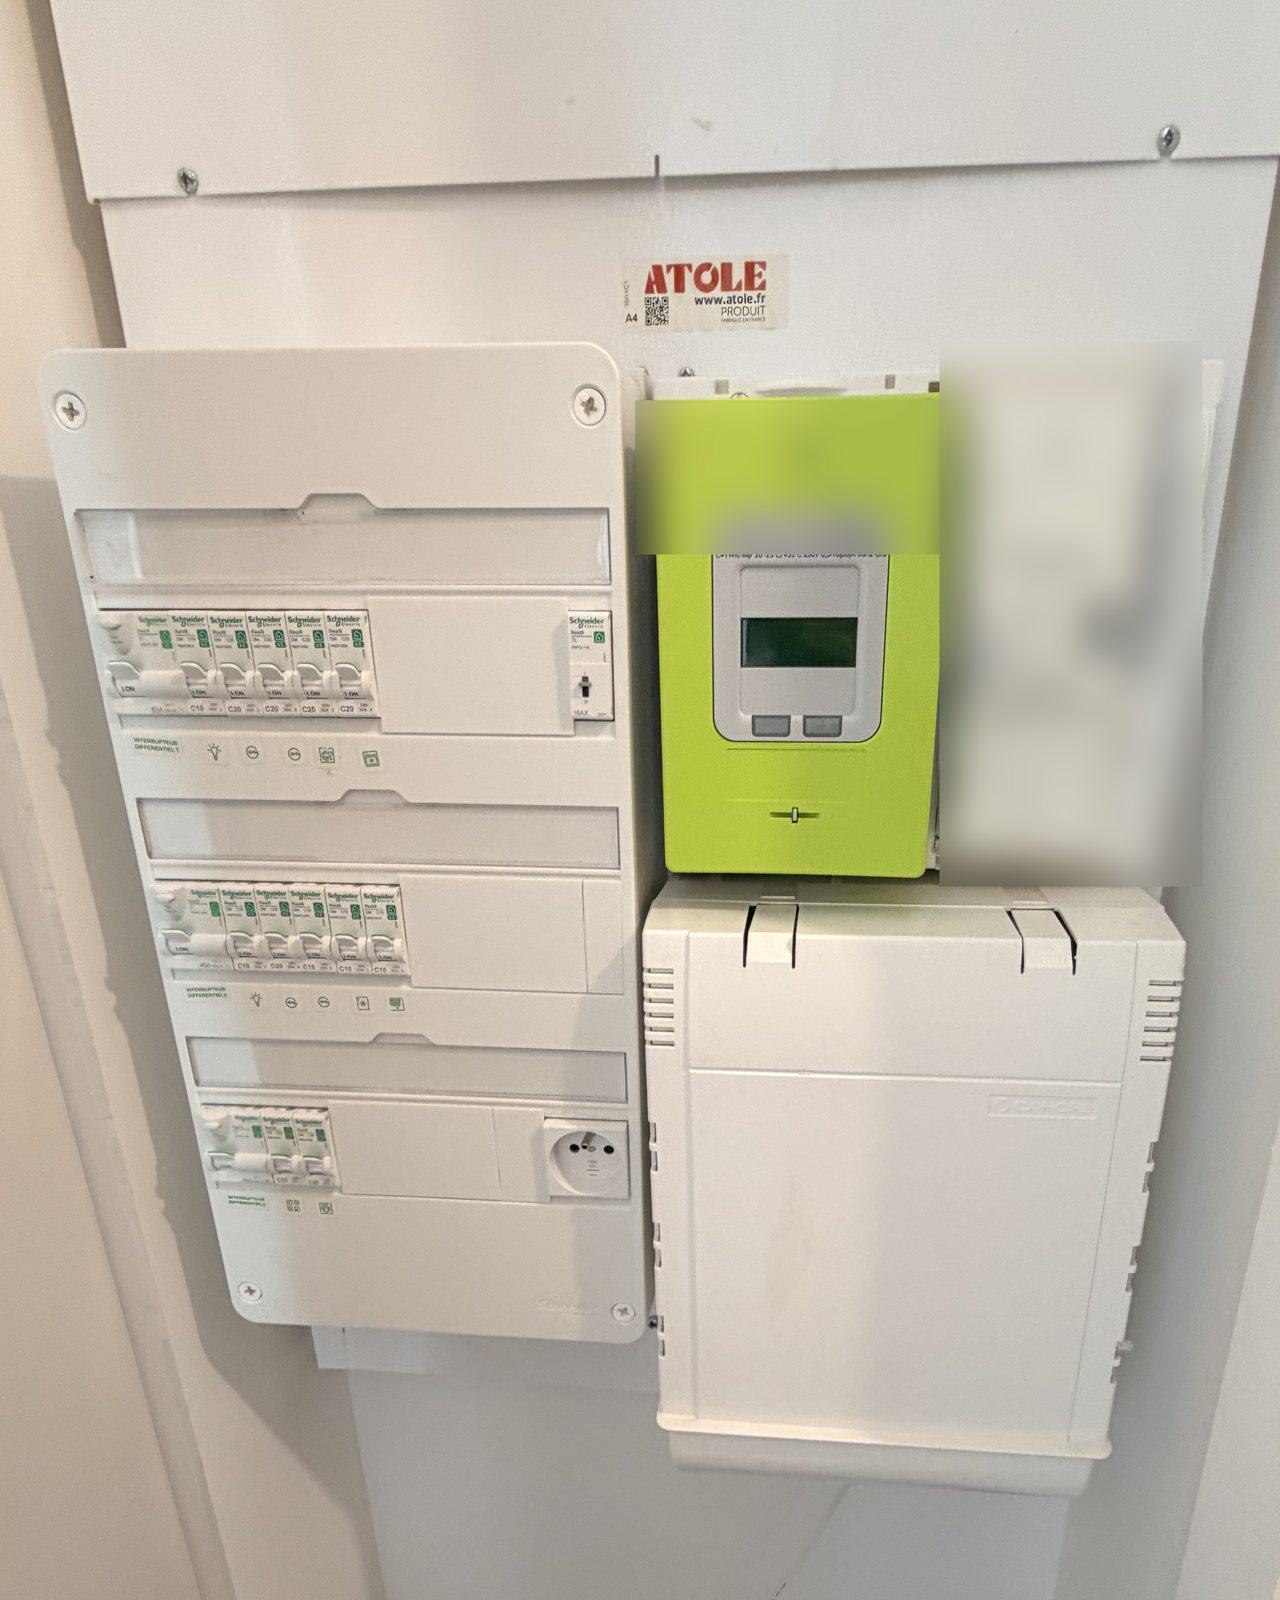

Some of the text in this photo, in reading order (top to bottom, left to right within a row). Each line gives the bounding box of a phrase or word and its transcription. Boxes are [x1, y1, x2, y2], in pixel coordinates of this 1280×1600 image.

[644, 261, 767, 294] ATOLE
[694, 292, 766, 305] www.atole.fr
[721, 305, 766, 317] PRODUIT
[625, 313, 638, 323] A4
[171, 615, 204, 627] Schneider
[210, 616, 243, 628] Schneider
[248, 615, 282, 628] Schneider
[287, 615, 321, 628] Schneider
[326, 615, 360, 627] Schneider
[569, 616, 604, 629] Schneider
[228, 705, 241, 713] C20
[222, 890, 252, 899] Schneider
[256, 889, 287, 900] Schneider
[290, 891, 321, 900] Schneider
[328, 892, 358, 902] Schneider
[363, 893, 394, 902] Schneider
